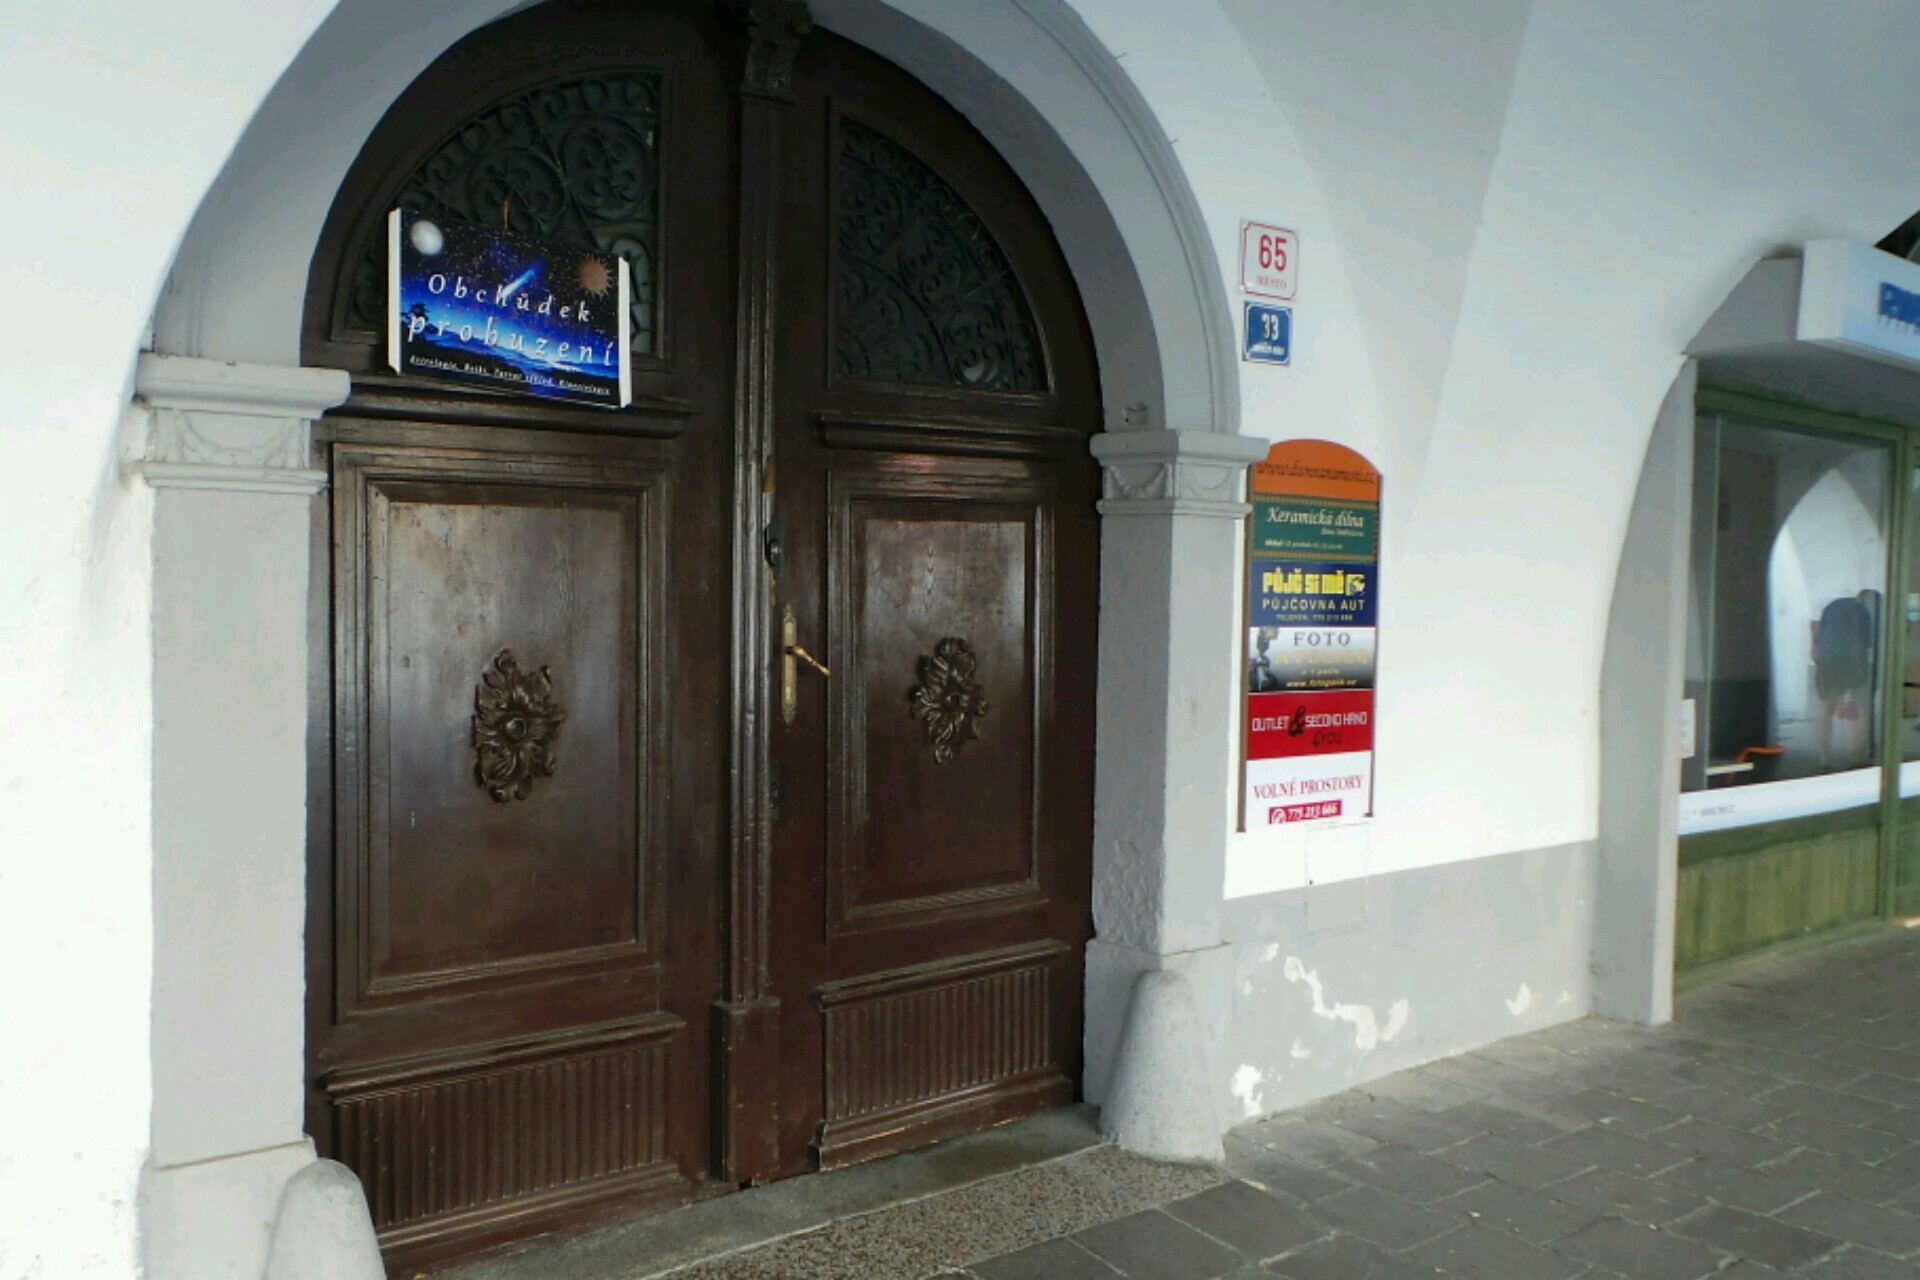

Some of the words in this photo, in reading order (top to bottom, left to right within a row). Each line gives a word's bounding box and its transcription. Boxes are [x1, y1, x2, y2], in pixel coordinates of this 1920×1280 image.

[1259, 234, 1287, 272] 65
[428, 273, 592, 323] Obchůdek
[407, 313, 613, 367] probuzení
[1262, 313, 1279, 341] 33
[1266, 507, 1333, 526] Keramická
[1263, 597, 1335, 611] PŮJČOVNA
[1341, 599, 1365, 611] AUT
[1294, 632, 1351, 646] FOTO
[1252, 716, 1290, 731] OUTLET
[1288, 705, 1306, 737] &
[1305, 713, 1342, 728] SECOND
[1343, 711, 1367, 725] HAND
[1253, 777, 1297, 799] VOLNÉ
[1300, 775, 1363, 795] PROSTORY
